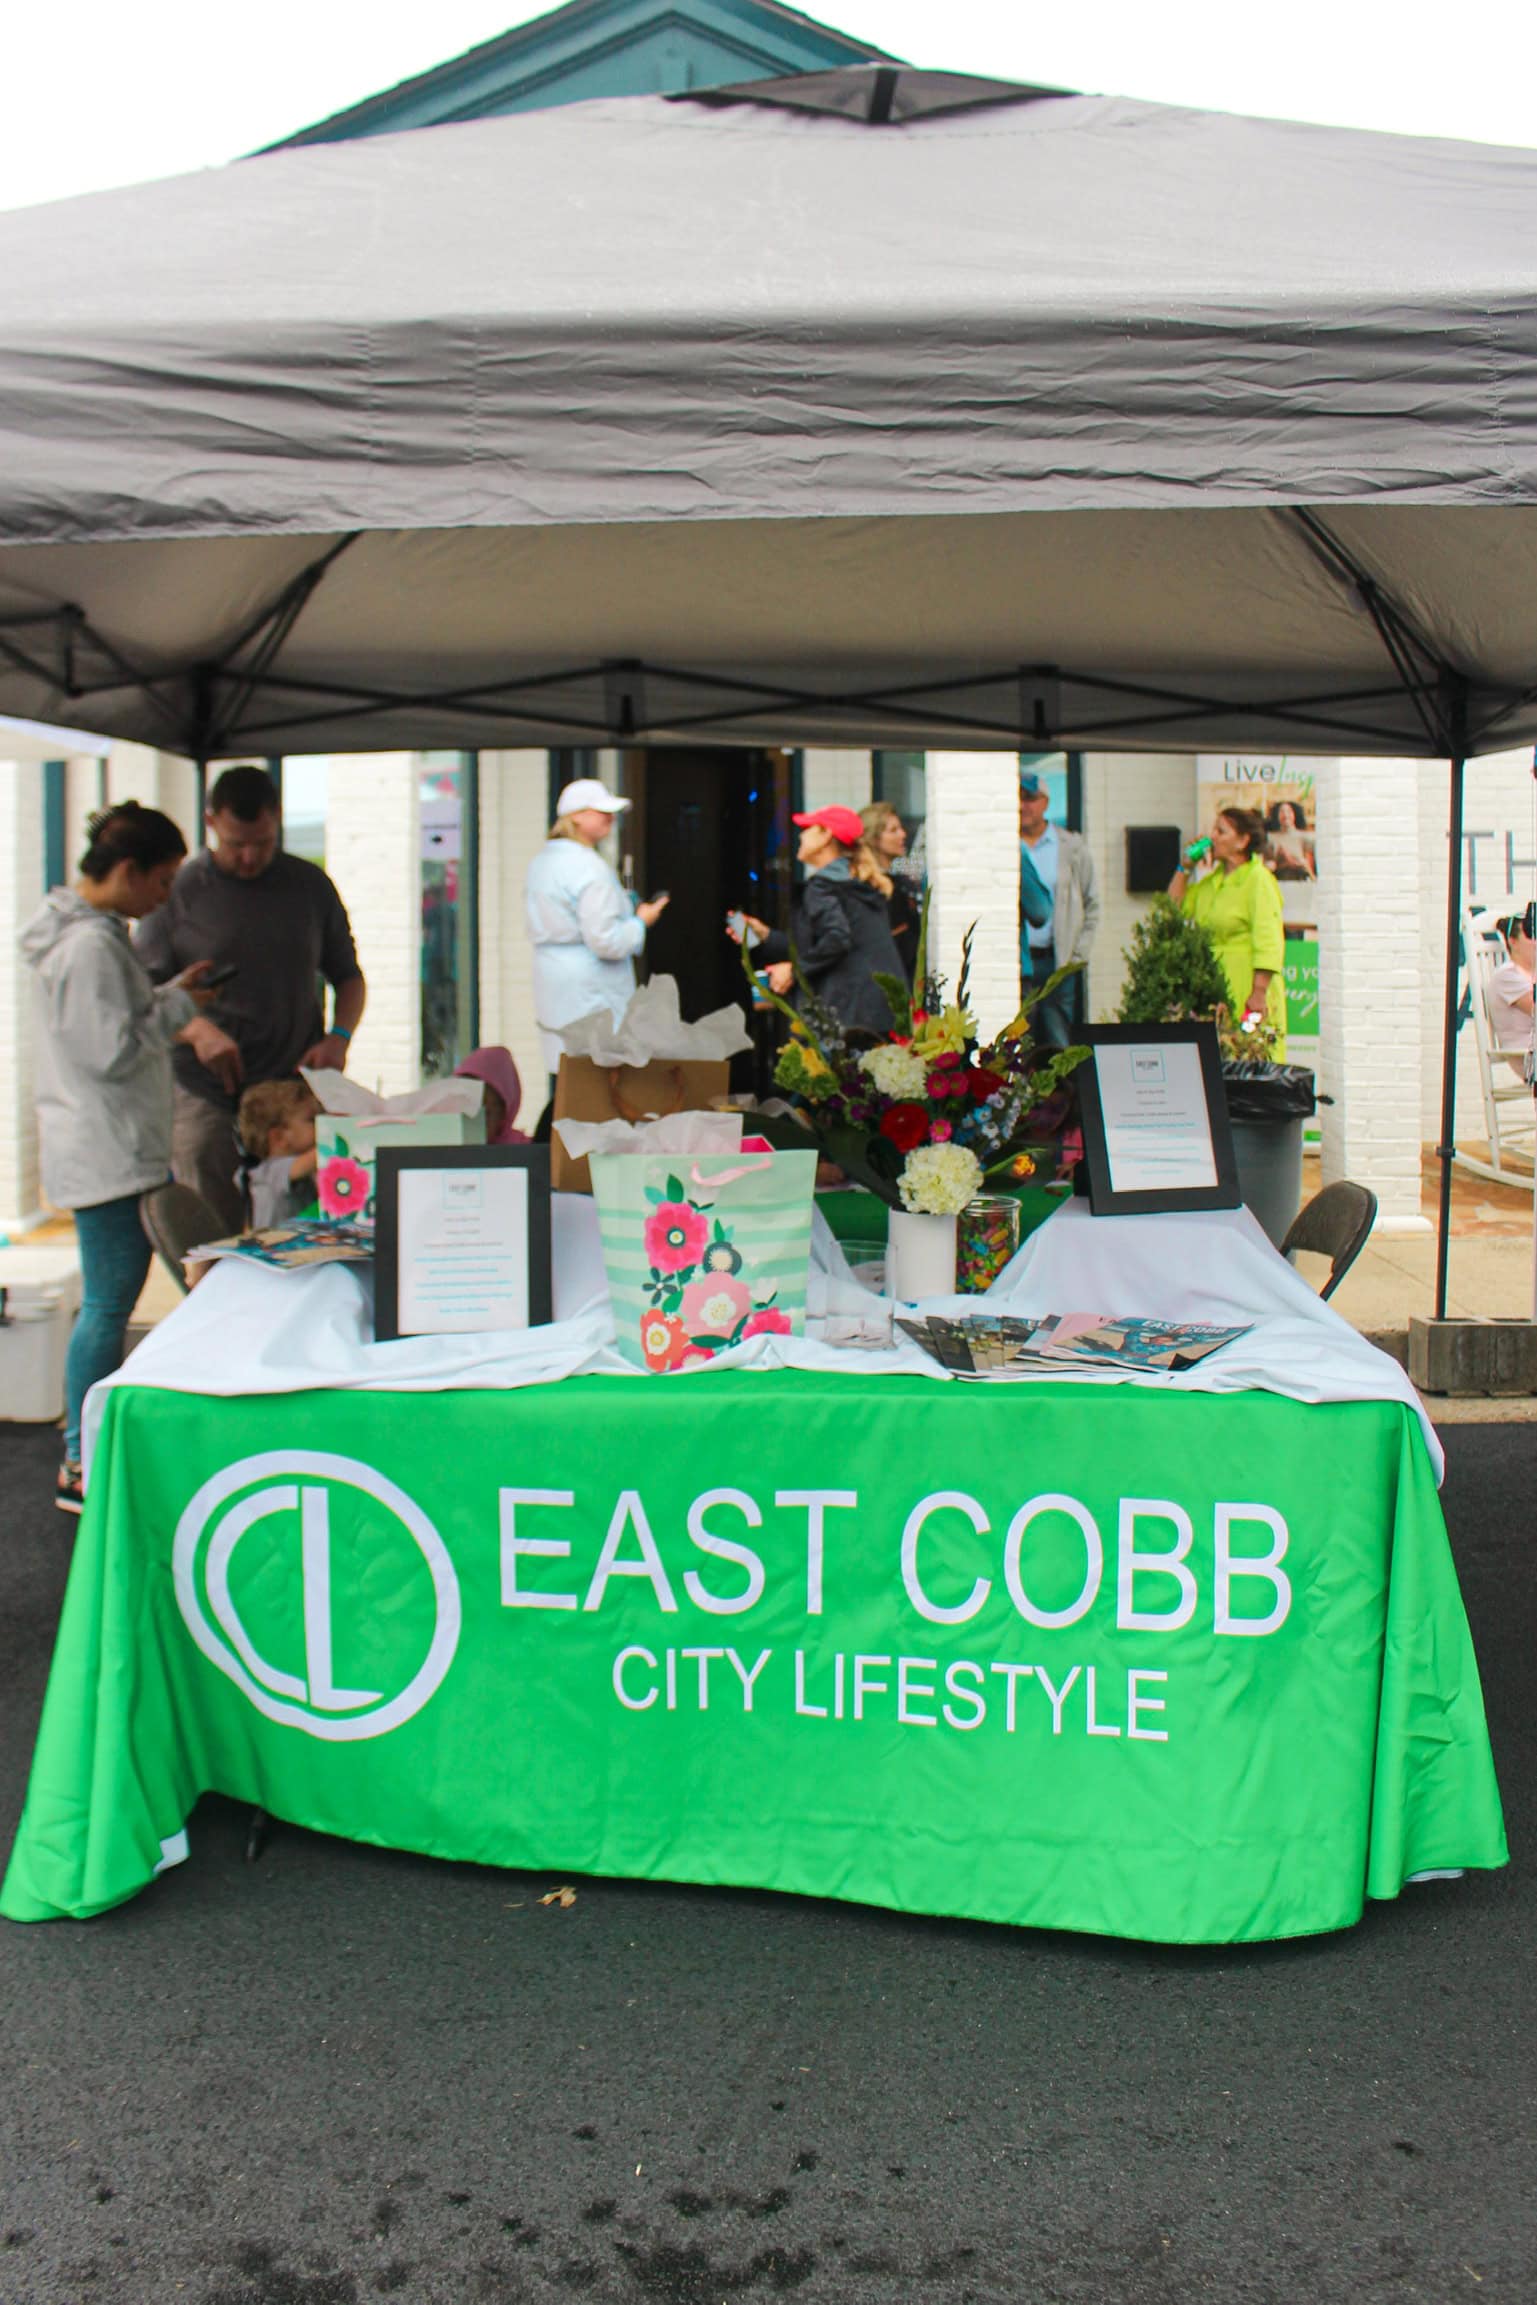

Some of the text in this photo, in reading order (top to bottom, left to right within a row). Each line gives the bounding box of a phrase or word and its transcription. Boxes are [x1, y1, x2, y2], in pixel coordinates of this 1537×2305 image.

[1224, 759, 1275, 782] Live
[499, 1487, 1292, 1637] EAST COBB
[613, 1646, 1169, 1742] CITY LIFESTYLE
